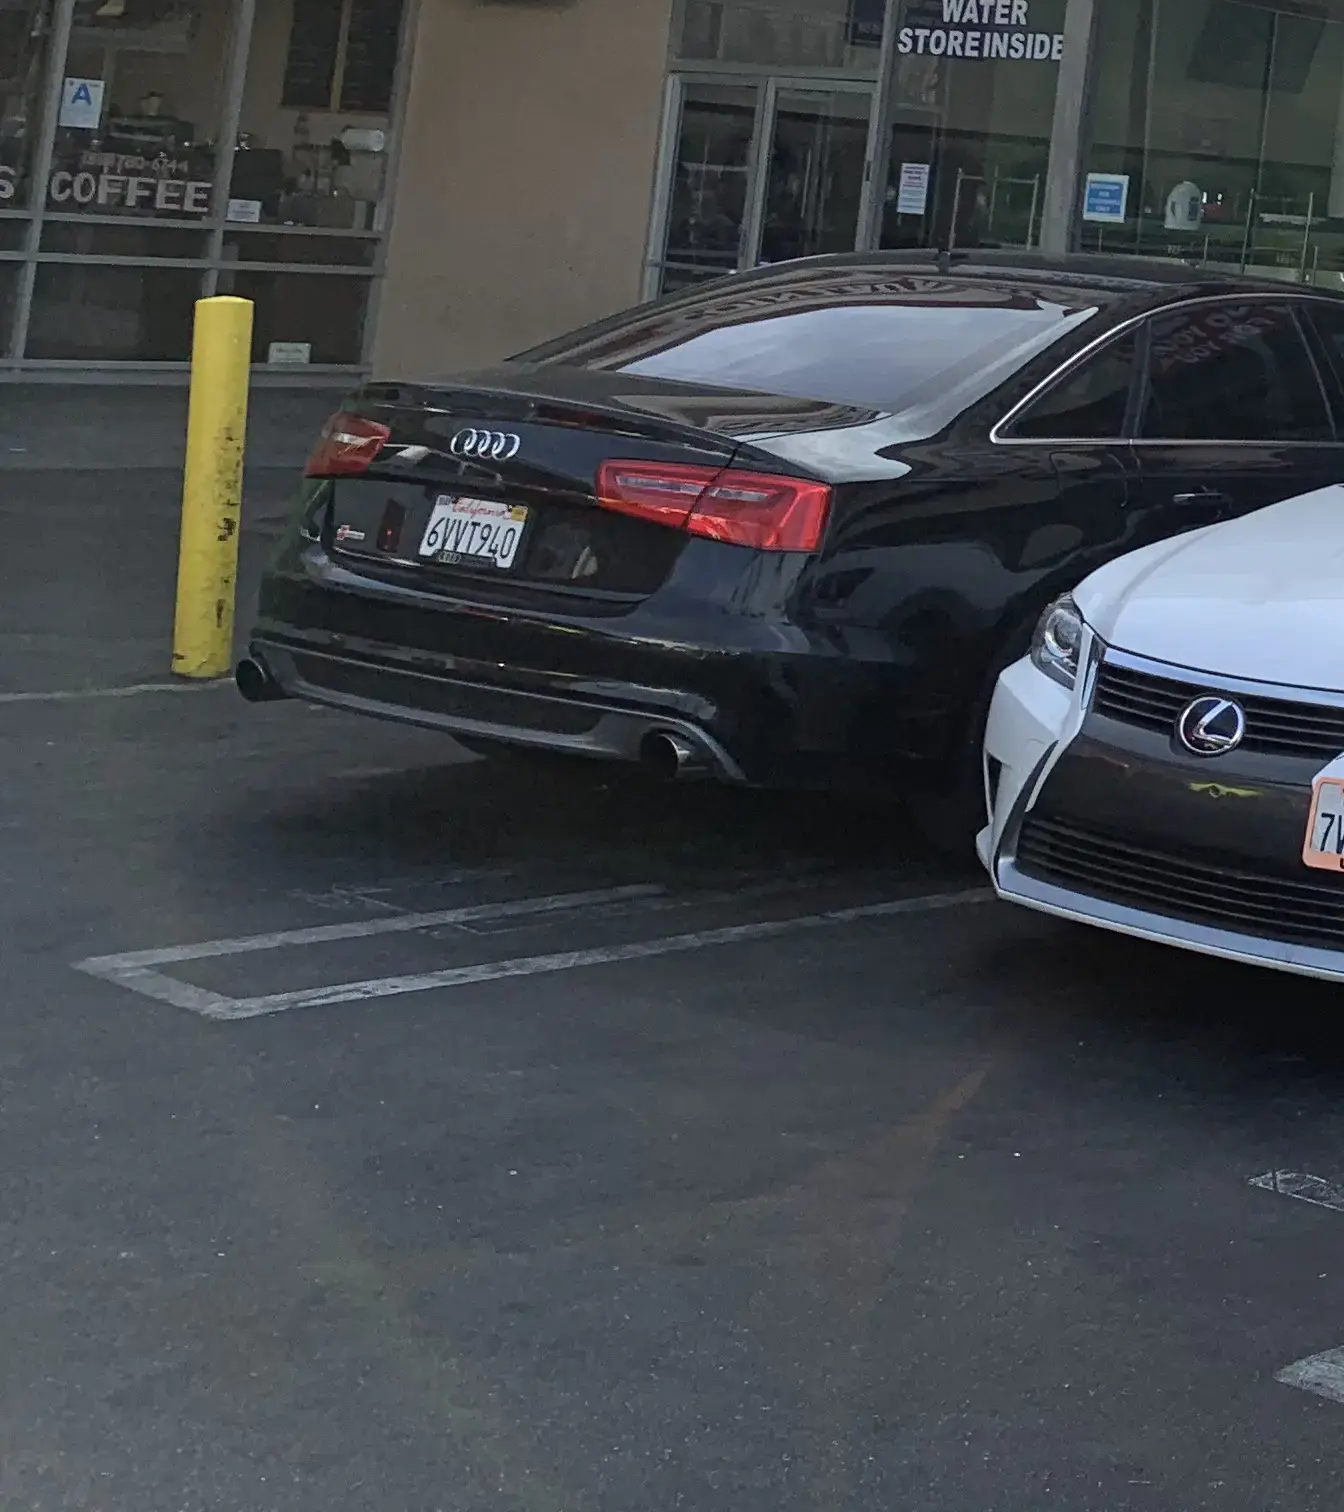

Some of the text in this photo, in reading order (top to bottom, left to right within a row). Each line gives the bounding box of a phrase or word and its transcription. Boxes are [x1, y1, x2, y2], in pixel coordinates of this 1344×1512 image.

[898, 28, 1064, 60] STORE INSIDE
[72, 84, 91, 106] A
[51, 171, 212, 212] COFFEE
[427, 517, 516, 559] 6VVT940
